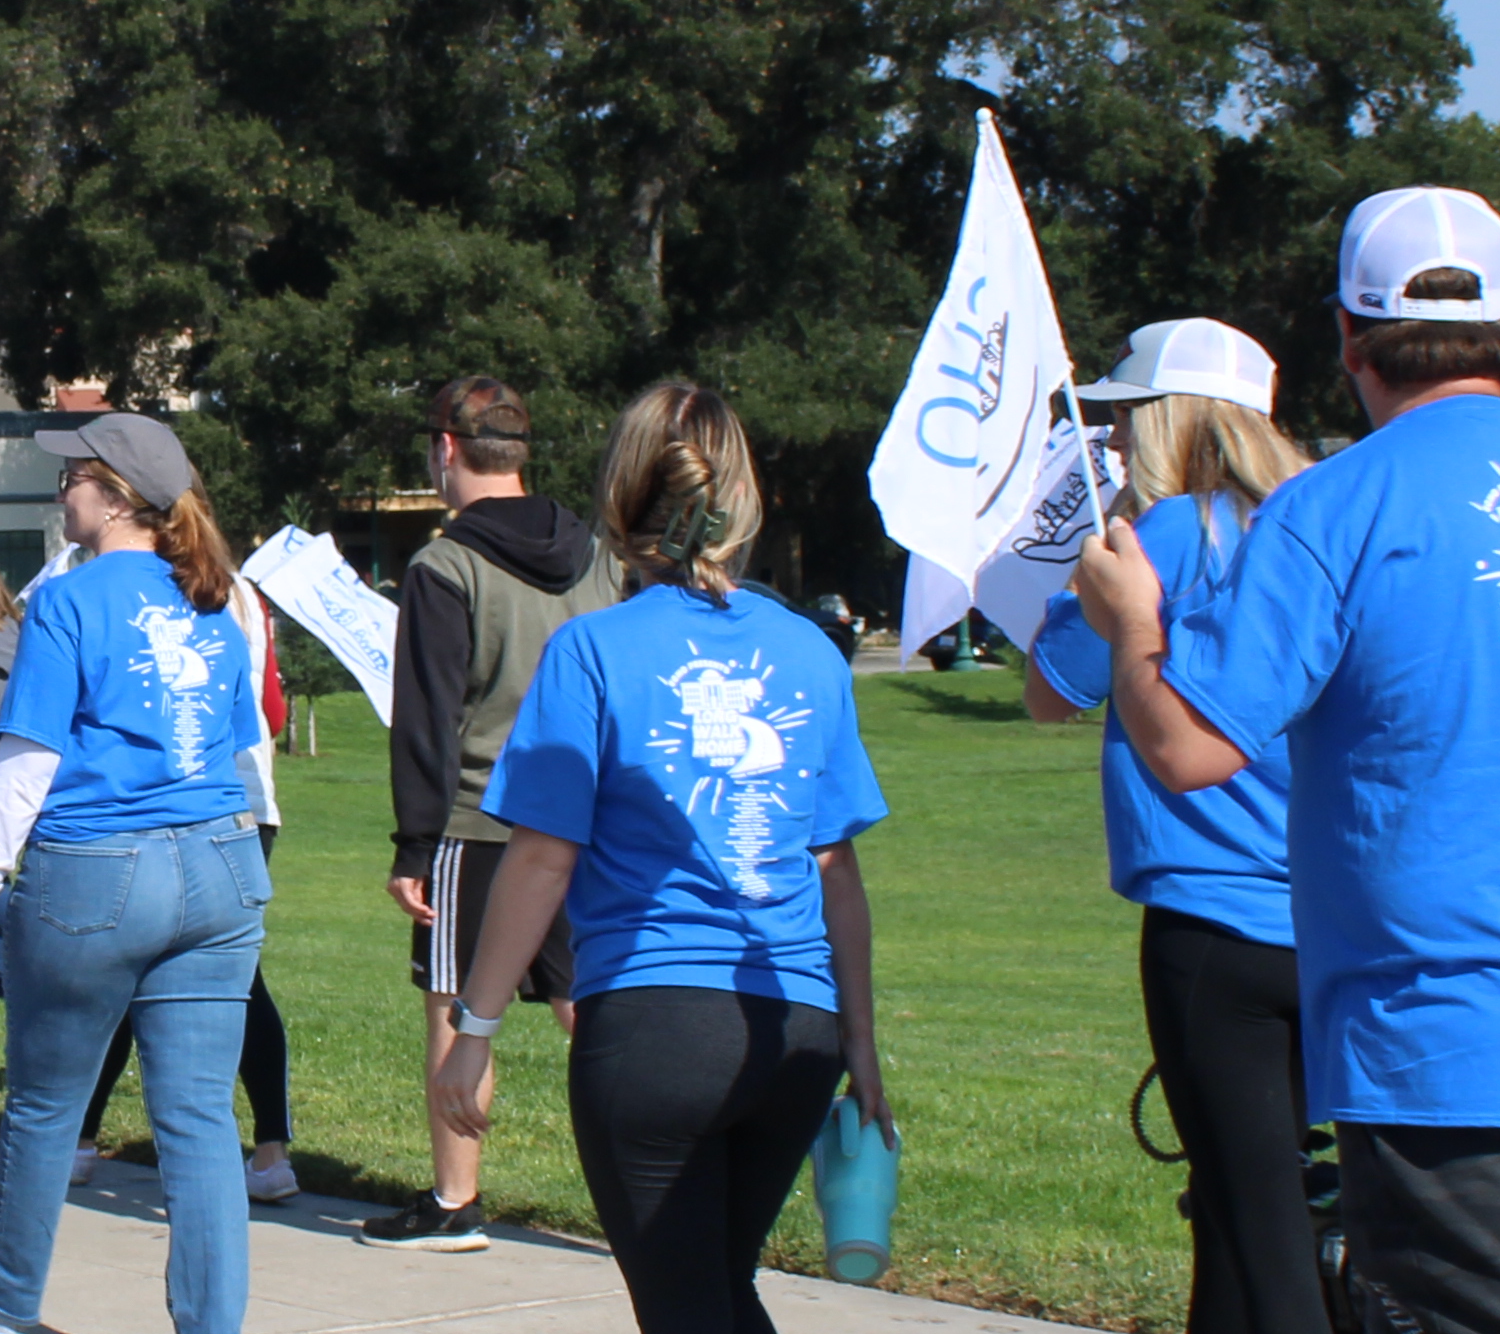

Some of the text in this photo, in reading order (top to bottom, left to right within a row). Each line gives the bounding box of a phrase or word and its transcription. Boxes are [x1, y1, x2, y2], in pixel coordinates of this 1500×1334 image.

[693, 709, 741, 724] LONG
[692, 724, 742, 739] WALK
[691, 739, 748, 758] HOME
[709, 757, 736, 767] 2023
